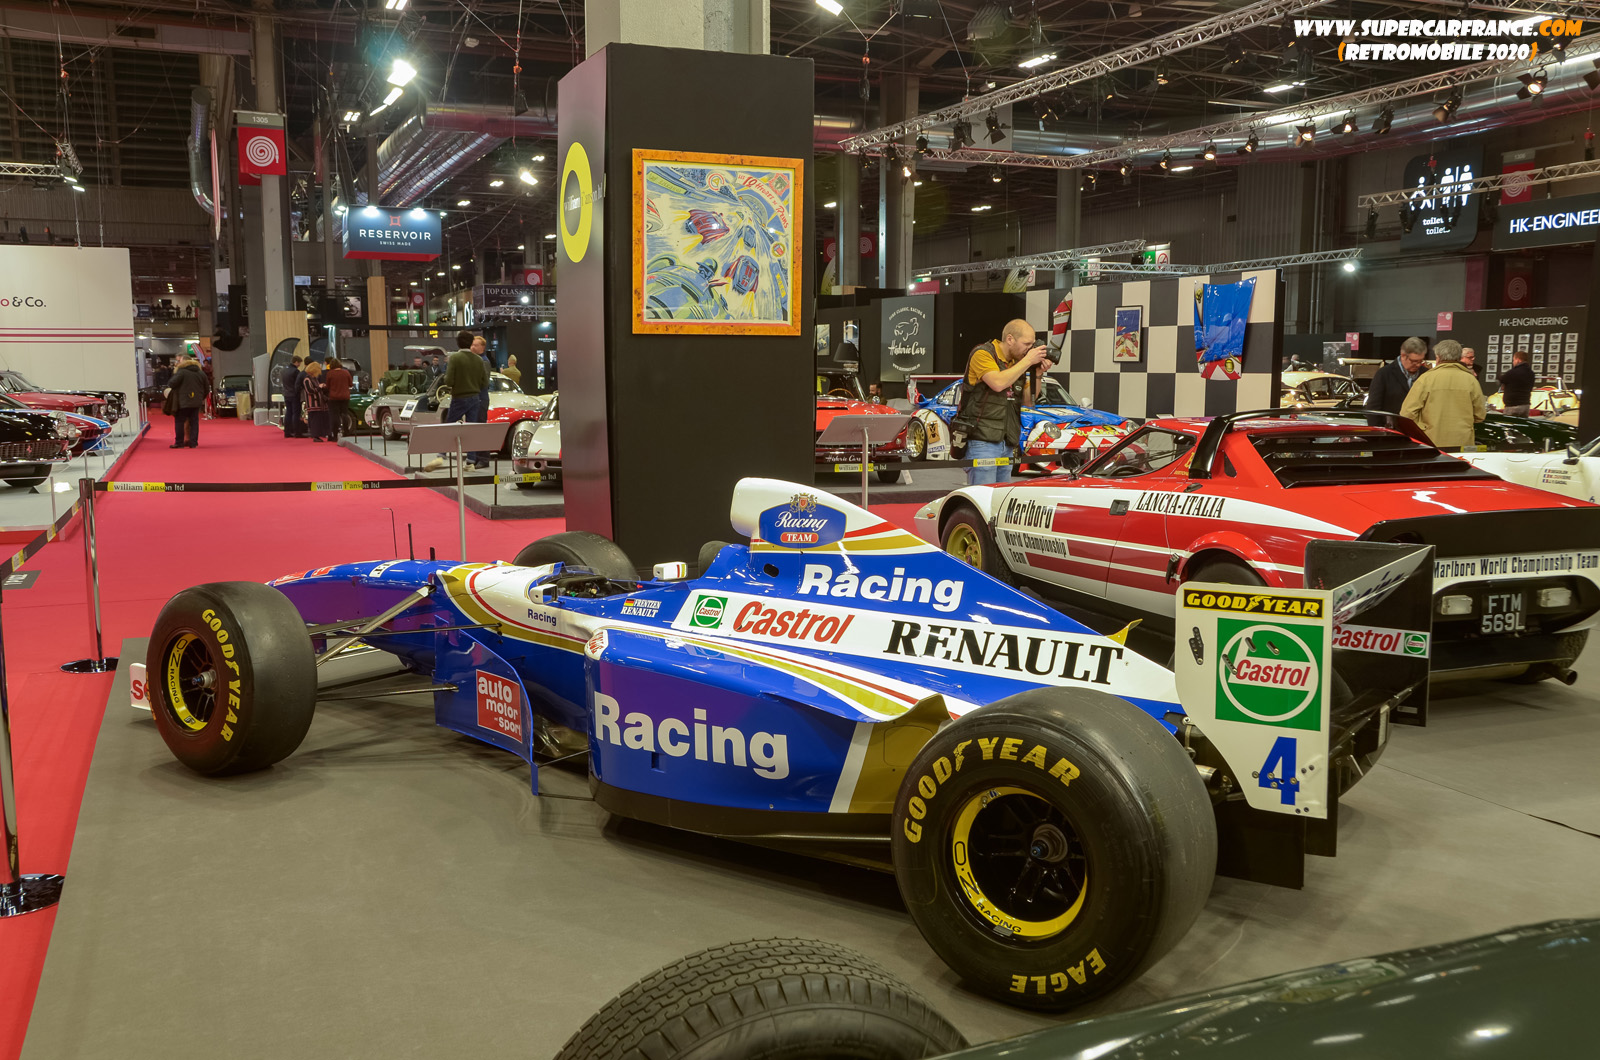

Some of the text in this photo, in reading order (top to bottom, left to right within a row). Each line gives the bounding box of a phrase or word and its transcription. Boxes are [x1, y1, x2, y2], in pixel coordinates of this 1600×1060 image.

[252, 116, 269, 124] 1305
[359, 229, 432, 240] RESERVOIR
[12, 296, 23, 307] &
[25, 296, 47, 308] Co.
[1499, 316, 1569, 327] HK-ENGINEERING
[113, 483, 143, 491] william
[174, 483, 185, 491] ltd
[316, 482, 343, 490] william
[370, 481, 380, 489] ltd
[499, 474, 523, 483] william
[1004, 497, 1053, 529] Marlboro
[1136, 491, 1226, 518] LANCIA-ITALIA
[774, 511, 829, 532] Racing
[786, 533, 813, 542] TEAM
[1004, 530, 1067, 558] World Championship
[1009, 548, 1028, 566] Team
[1434, 552, 1599, 579] Marlboro World Championship Team
[798, 563, 965, 613] Racing
[620, 606, 659, 618] RENAULT
[633, 599, 662, 610] FRENTZEN
[698, 607, 722, 617] Castrol
[1488, 593, 1522, 614] FTM
[527, 608, 557, 627] Racing
[732, 600, 856, 645] Castrol
[1481, 611, 1526, 634] 569L
[1332, 624, 1402, 652] Castrol
[882, 619, 1125, 686] RENAULT
[1235, 658, 1311, 687] Castrol
[169, 667, 181, 705] RACING
[478, 676, 513, 703] auto
[485, 698, 519, 720] motor
[594, 690, 790, 780] Racing
[1258, 736, 1300, 806] 4
[976, 901, 1022, 934] RACING
[1010, 947, 1107, 995] EAGLE
